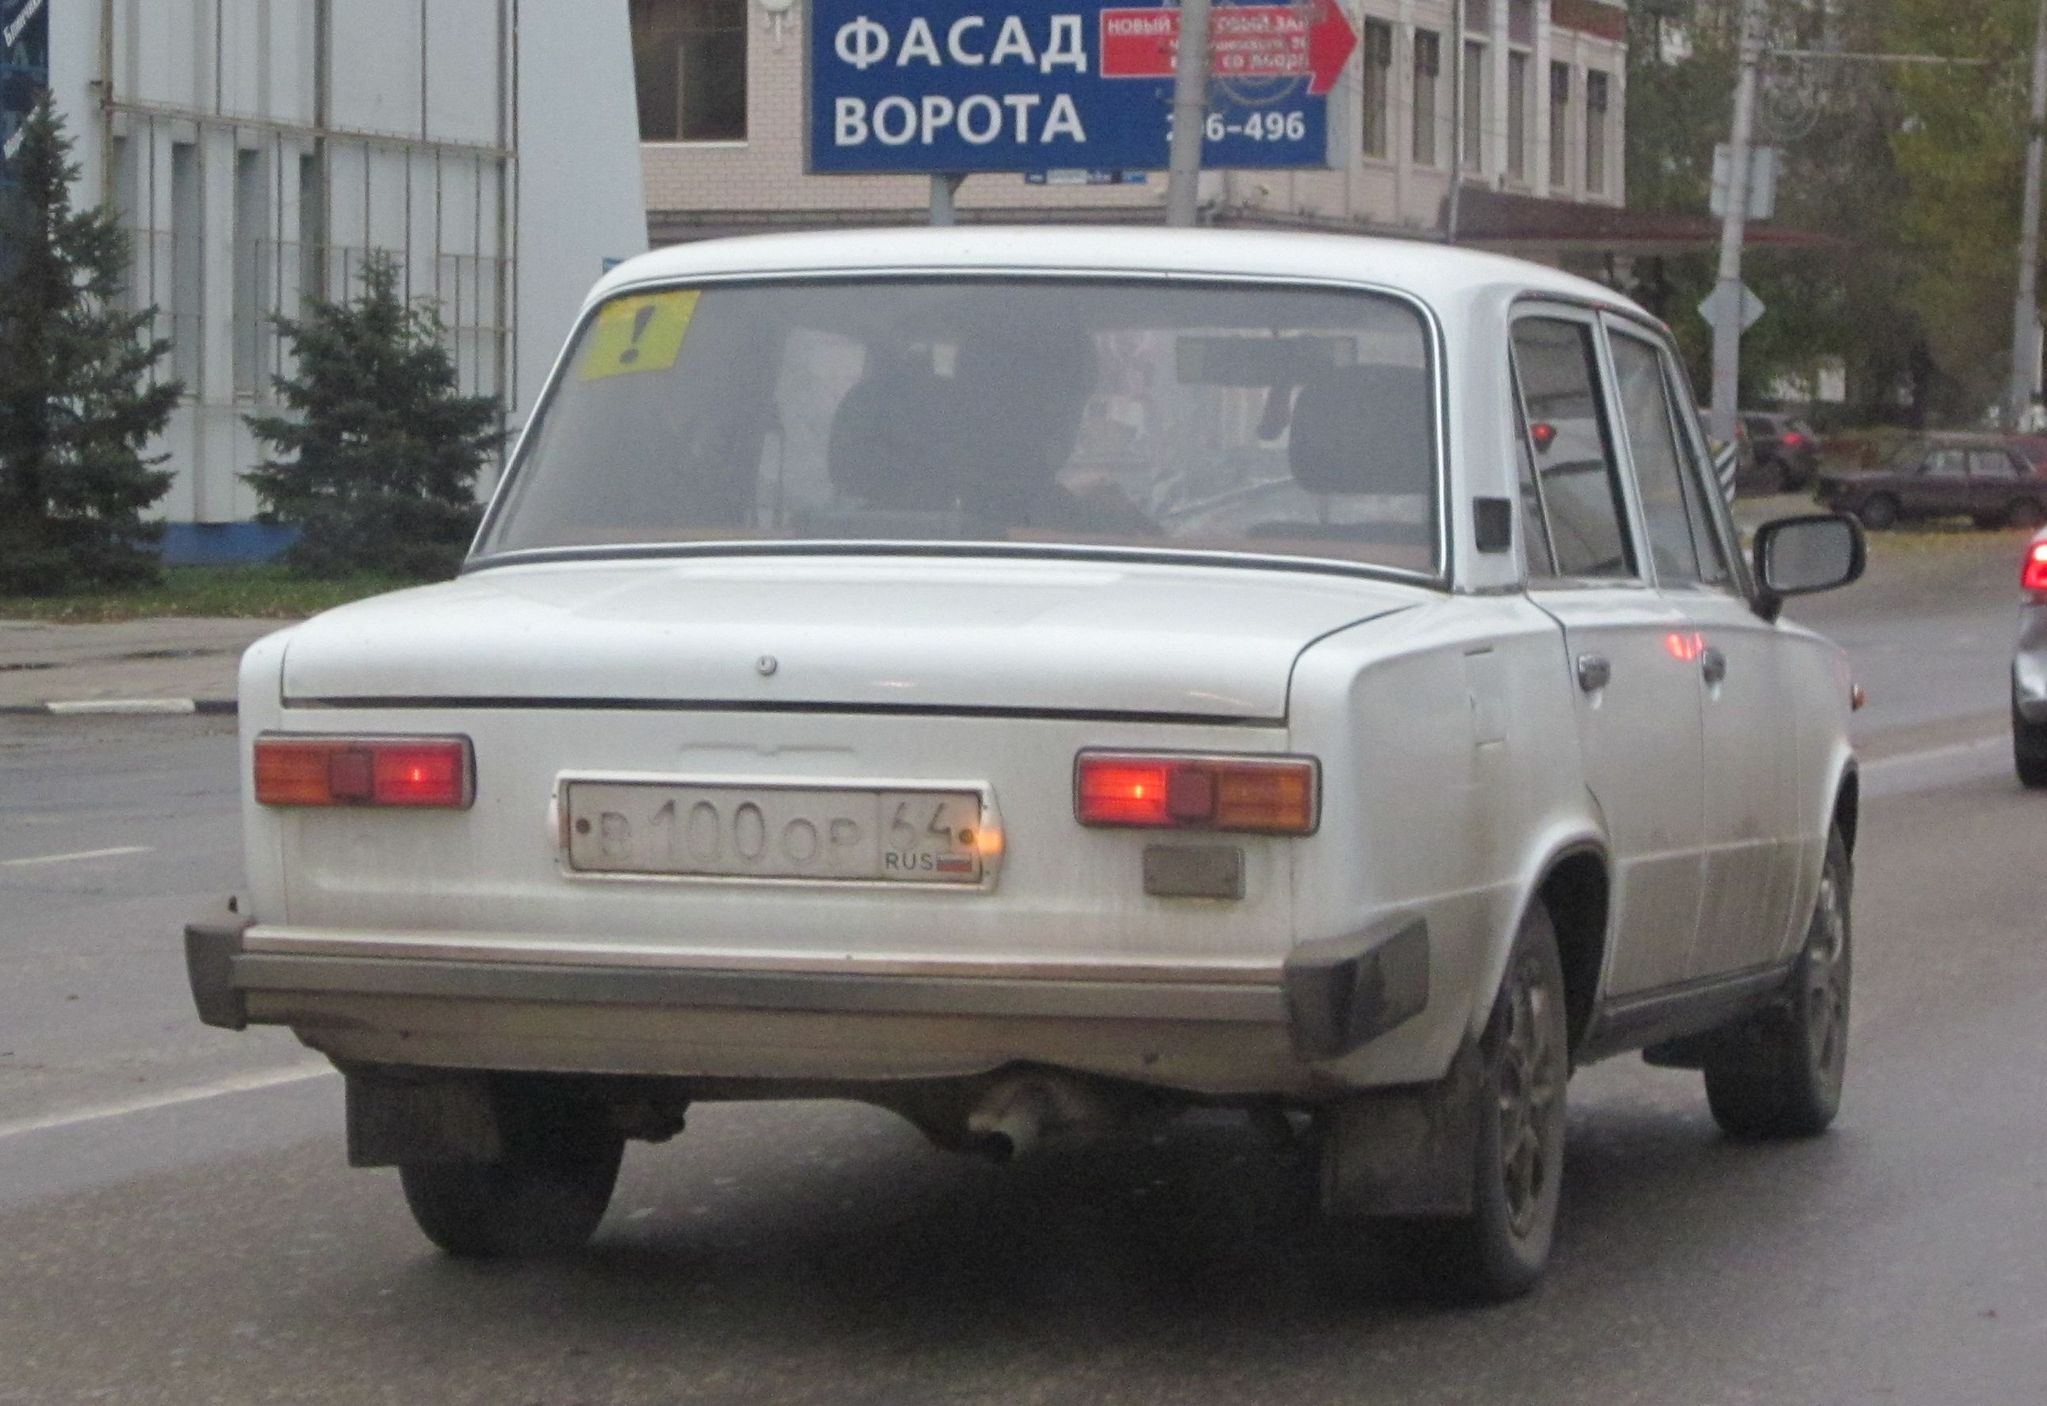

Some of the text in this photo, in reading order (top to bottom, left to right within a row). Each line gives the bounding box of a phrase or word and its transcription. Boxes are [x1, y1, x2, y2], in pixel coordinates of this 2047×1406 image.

[1107, 17, 1172, 35] НОВЫЙ
[834, 15, 1088, 73] ФАСАД
[834, 94, 1087, 146] ВОРОТА
[885, 852, 934, 871] RUS
